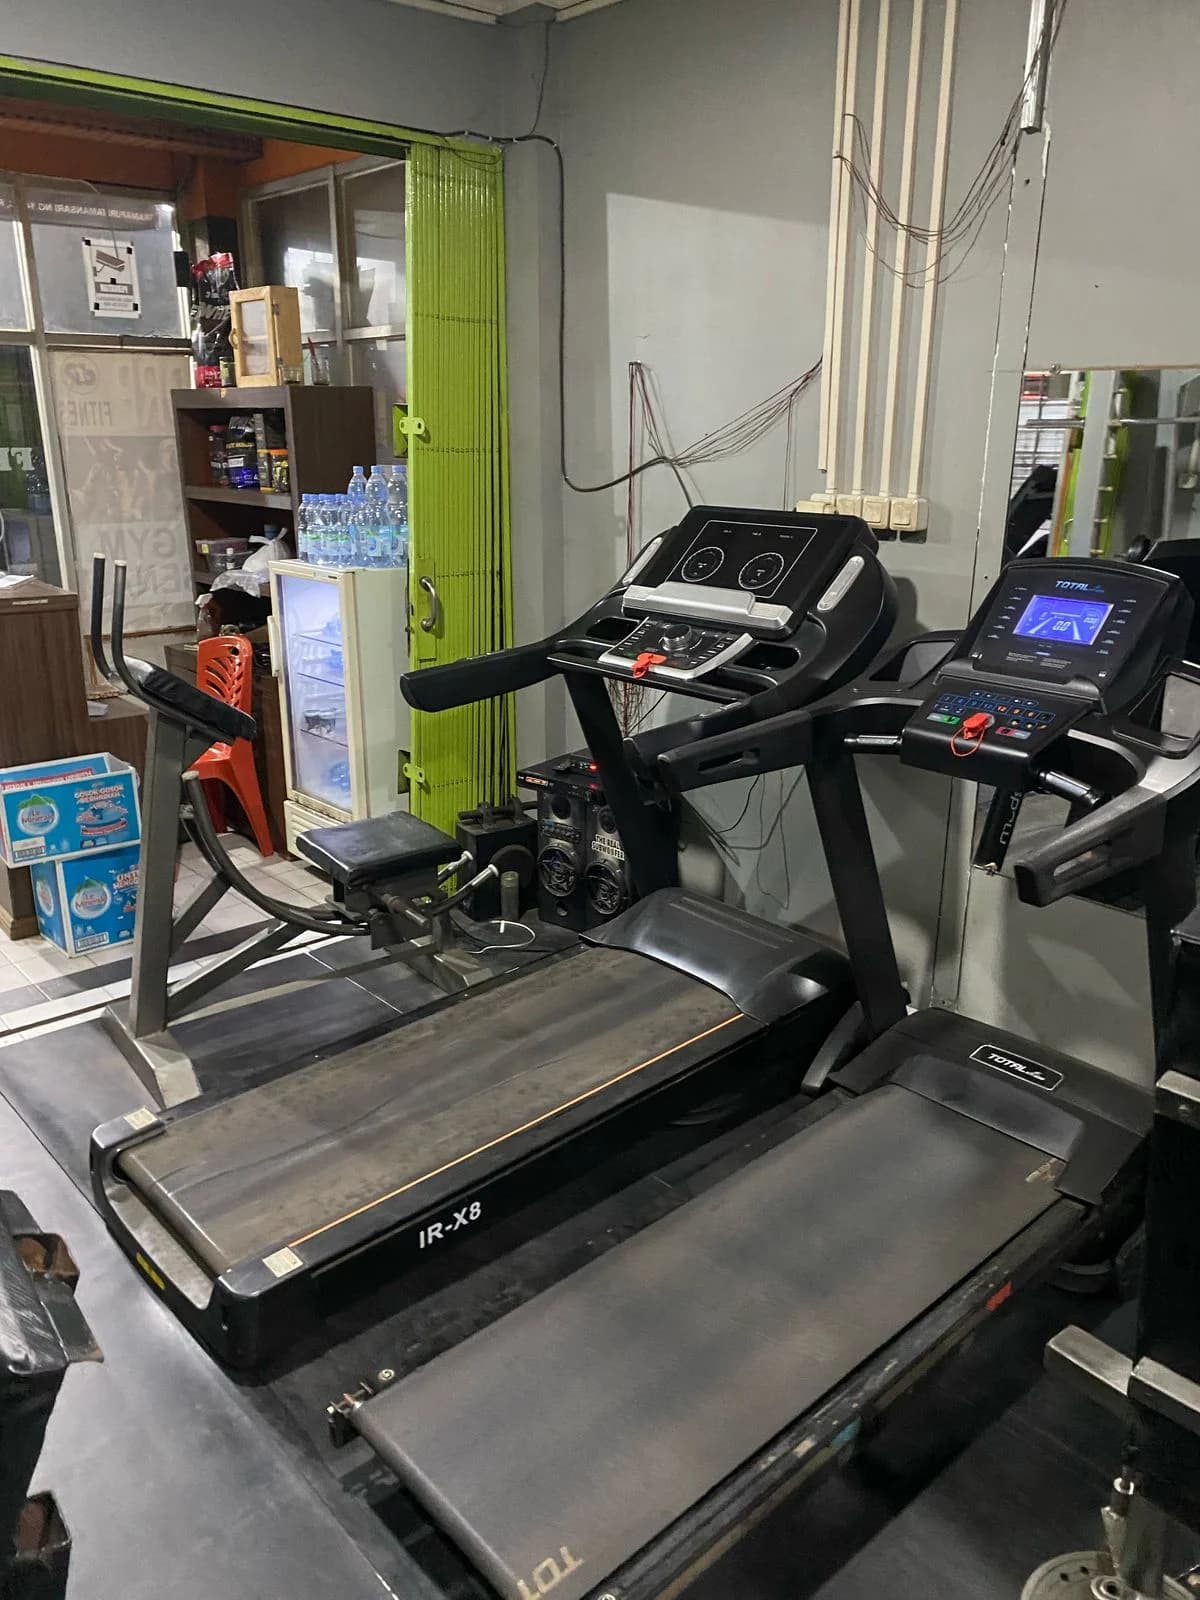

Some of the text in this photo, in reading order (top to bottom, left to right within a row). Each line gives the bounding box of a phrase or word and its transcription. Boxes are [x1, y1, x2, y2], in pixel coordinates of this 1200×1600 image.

[1055, 580, 1089, 591] TOTAL
[987, 1053, 1028, 1073] TOTAL
[419, 1201, 482, 1249] IR-X8
